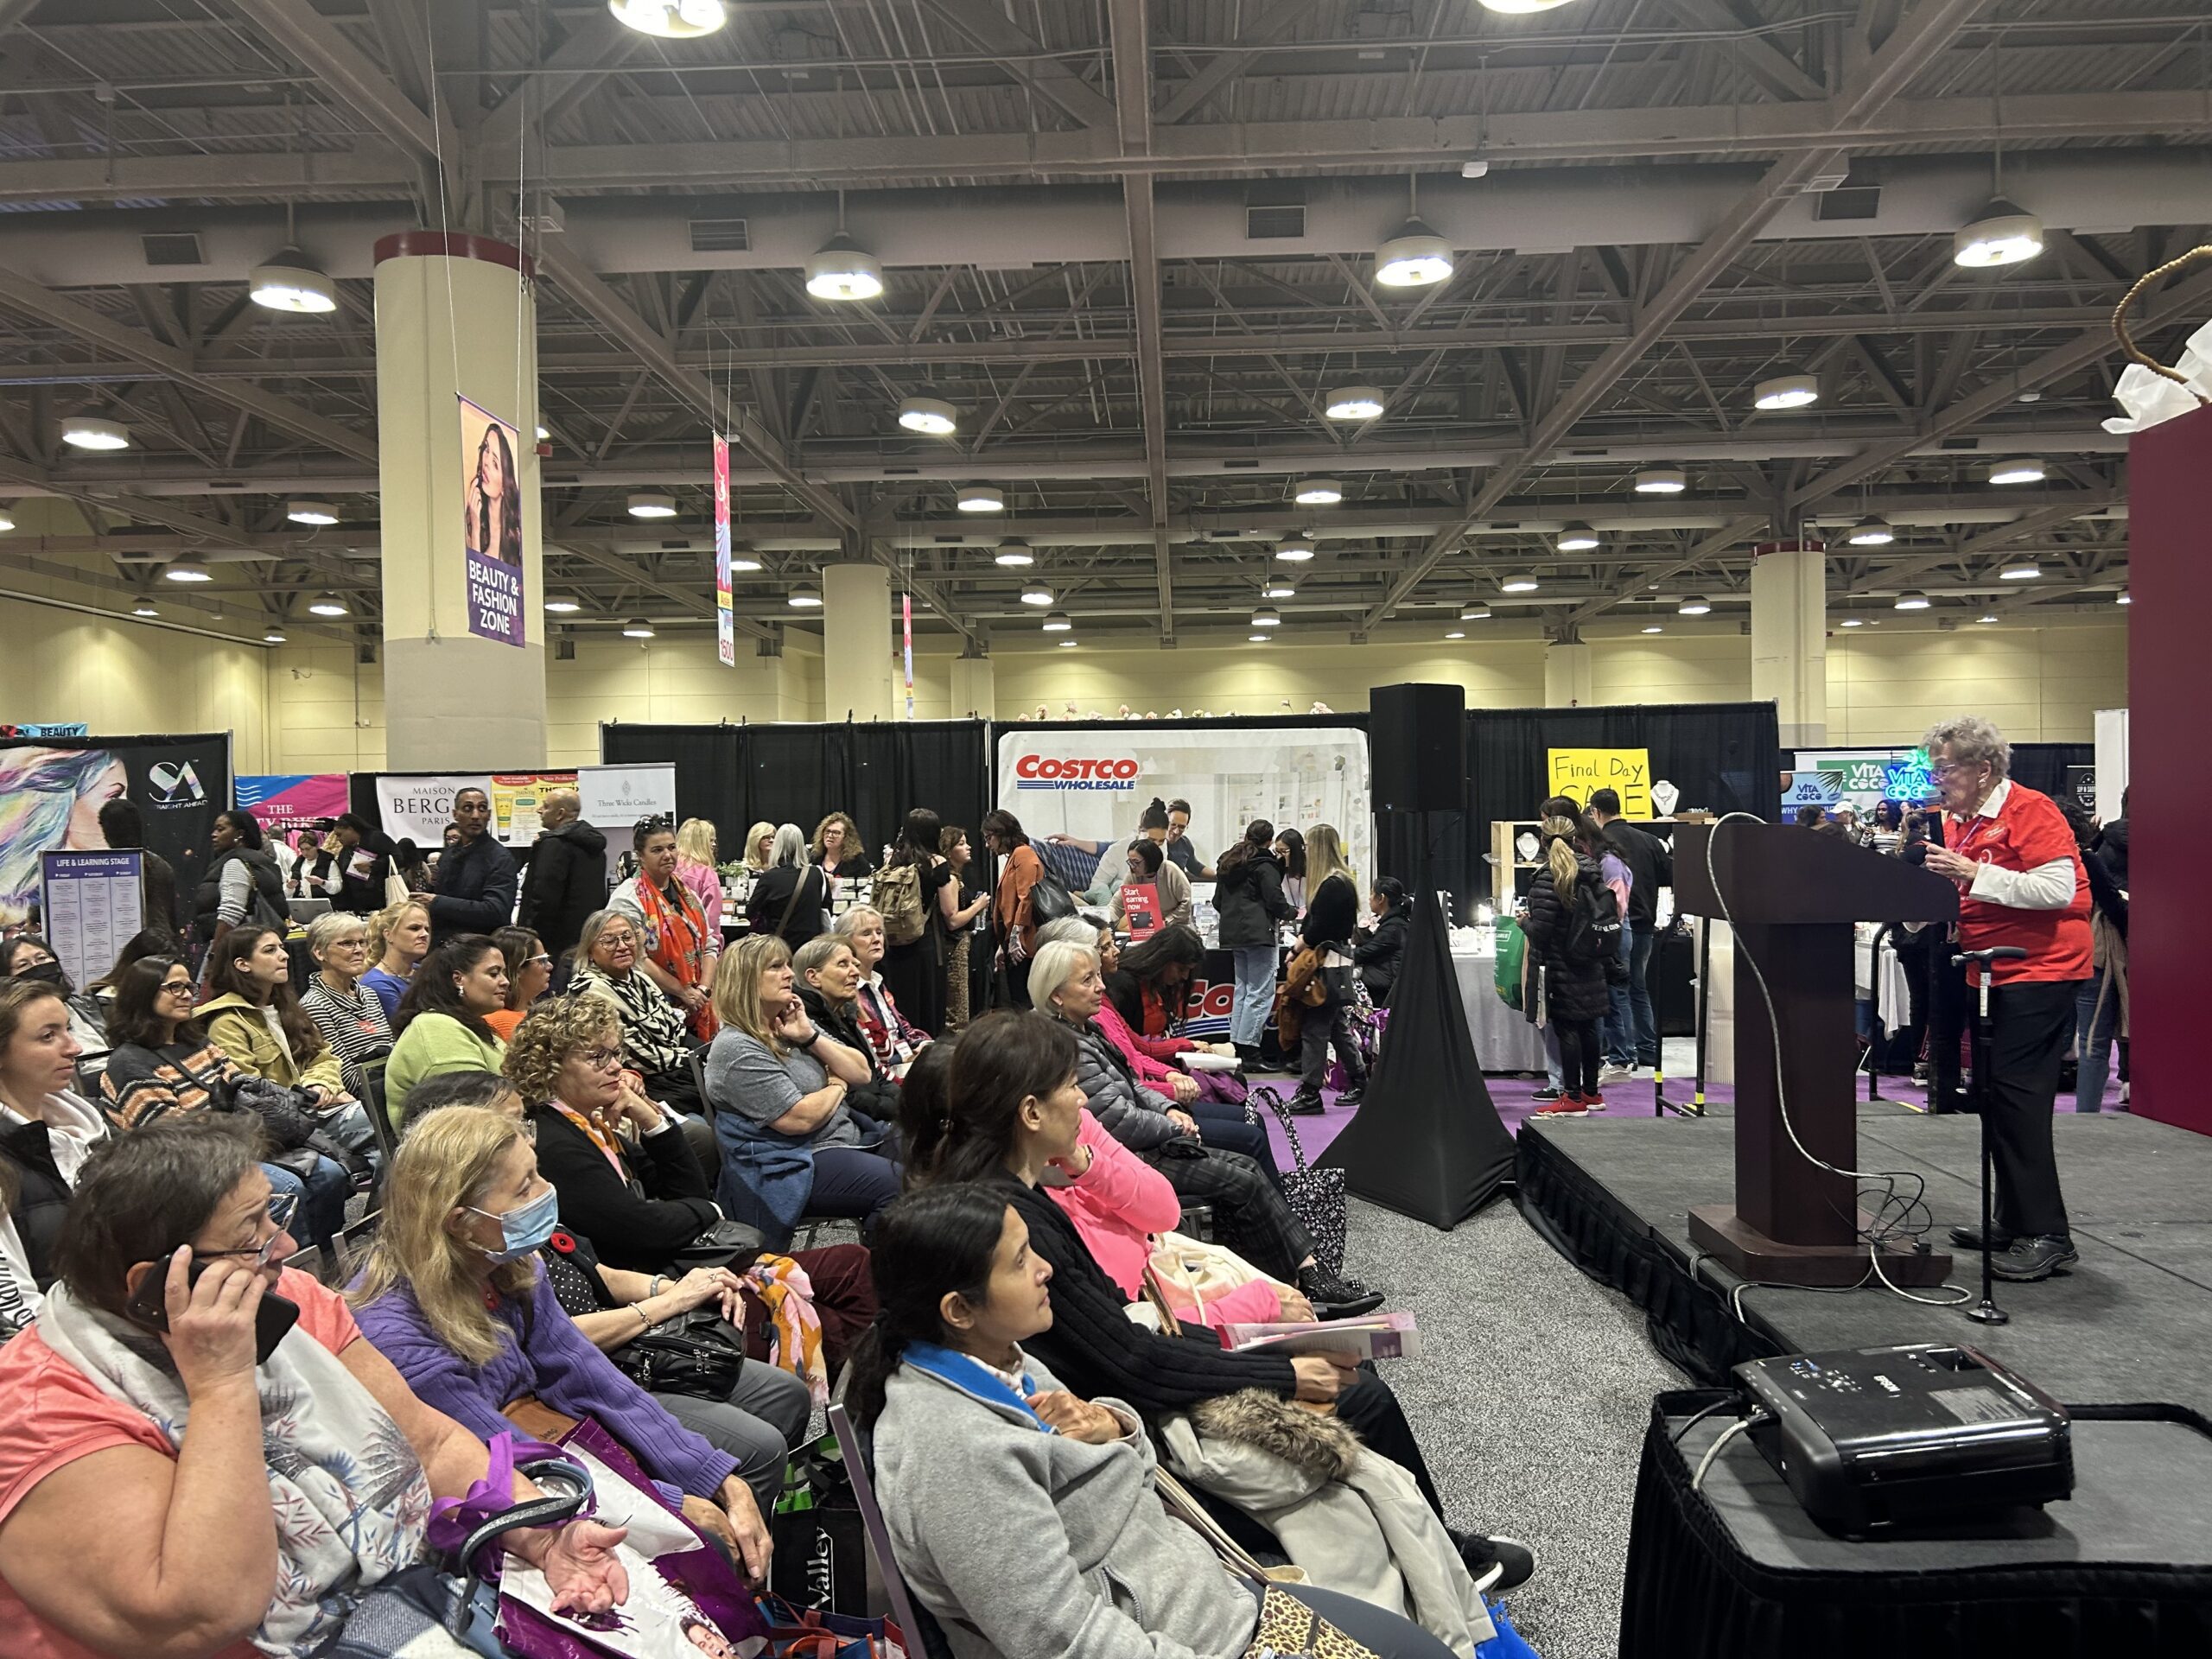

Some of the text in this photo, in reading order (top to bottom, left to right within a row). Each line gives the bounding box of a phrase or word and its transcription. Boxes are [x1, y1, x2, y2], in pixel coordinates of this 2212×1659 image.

[468, 558, 519, 596] BEAUTY &
[472, 582, 518, 616] FASHION
[480, 607, 510, 635] ZONE
[40, 727, 79, 737] BEAUTY
[1015, 754, 1138, 779] COSTCO
[1555, 755, 1643, 783] Final Day
[1851, 762, 1885, 778] VITA
[1887, 767, 1928, 785] VITA
[1053, 780, 1135, 790] WHOLESALE
[1797, 783, 1819, 793] VITA
[1848, 778, 1890, 790] COCO
[633, 798, 657, 806] Candles
[1796, 792, 1822, 801] COCO
[267, 804, 294, 814] THE
[393, 798, 450, 814] BERG
[1781, 806, 1797, 815] WHY
[422, 817, 450, 825] PARIS
[56, 859, 70, 868] LIFE
[77, 857, 110, 867] LEARNING
[110, 857, 130, 866] STAGE
[1123, 887, 1140, 896] Start
[806, 1526, 832, 1610] Valley
